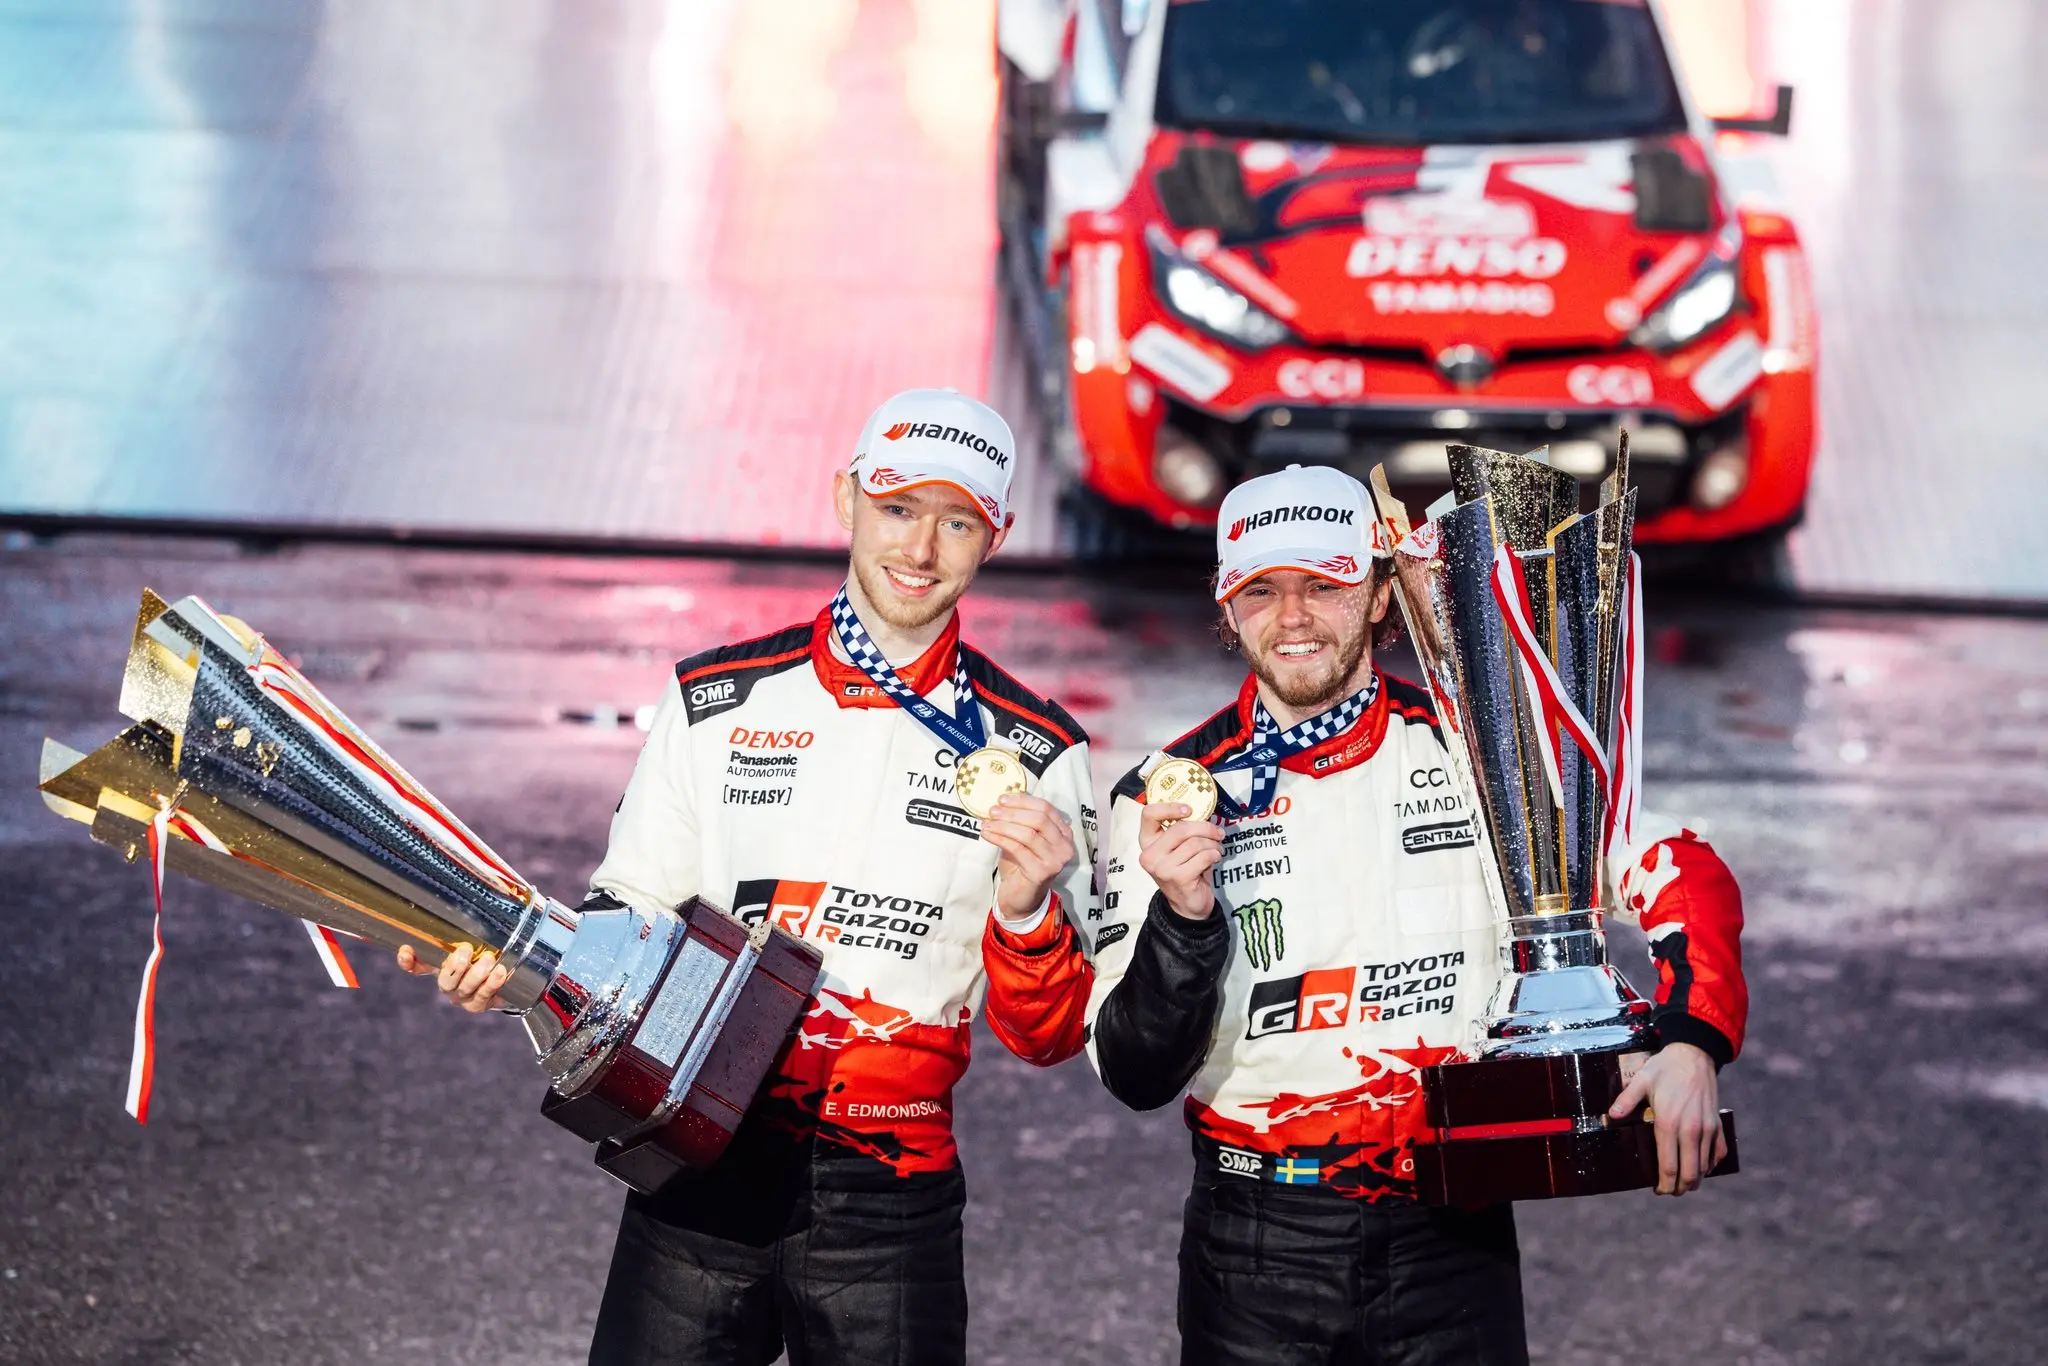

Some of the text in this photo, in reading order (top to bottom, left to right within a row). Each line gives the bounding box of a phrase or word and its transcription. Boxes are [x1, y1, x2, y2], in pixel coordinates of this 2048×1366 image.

[691, 682, 736, 705] OMP
[845, 685, 876, 697] GR
[729, 727, 814, 749] DENSO
[1008, 728, 1051, 758] OMP
[730, 750, 798, 766] Panasonic
[1314, 753, 1343, 770] GR
[726, 765, 798, 778] AUTOMOTIVE
[1410, 767, 1451, 788] CCI
[1394, 795, 1462, 818] TAMADI
[906, 805, 981, 832] CENTRAL
[1221, 823, 1284, 844] anasonic
[1402, 828, 1474, 848] CENTRAL
[1221, 836, 1288, 857] UTOMOTIVE
[831, 885, 944, 921] TOYOTA
[823, 906, 930, 937] GAZOO
[816, 924, 919, 960] Racing
[1363, 951, 1465, 982] TOYOTA
[1360, 972, 1457, 1003] GAZOO
[1252, 992, 1348, 1037] GR
[1360, 994, 1455, 1023] Racing
[825, 1102, 841, 1116] E.
[1218, 1151, 1262, 1173] OMP
